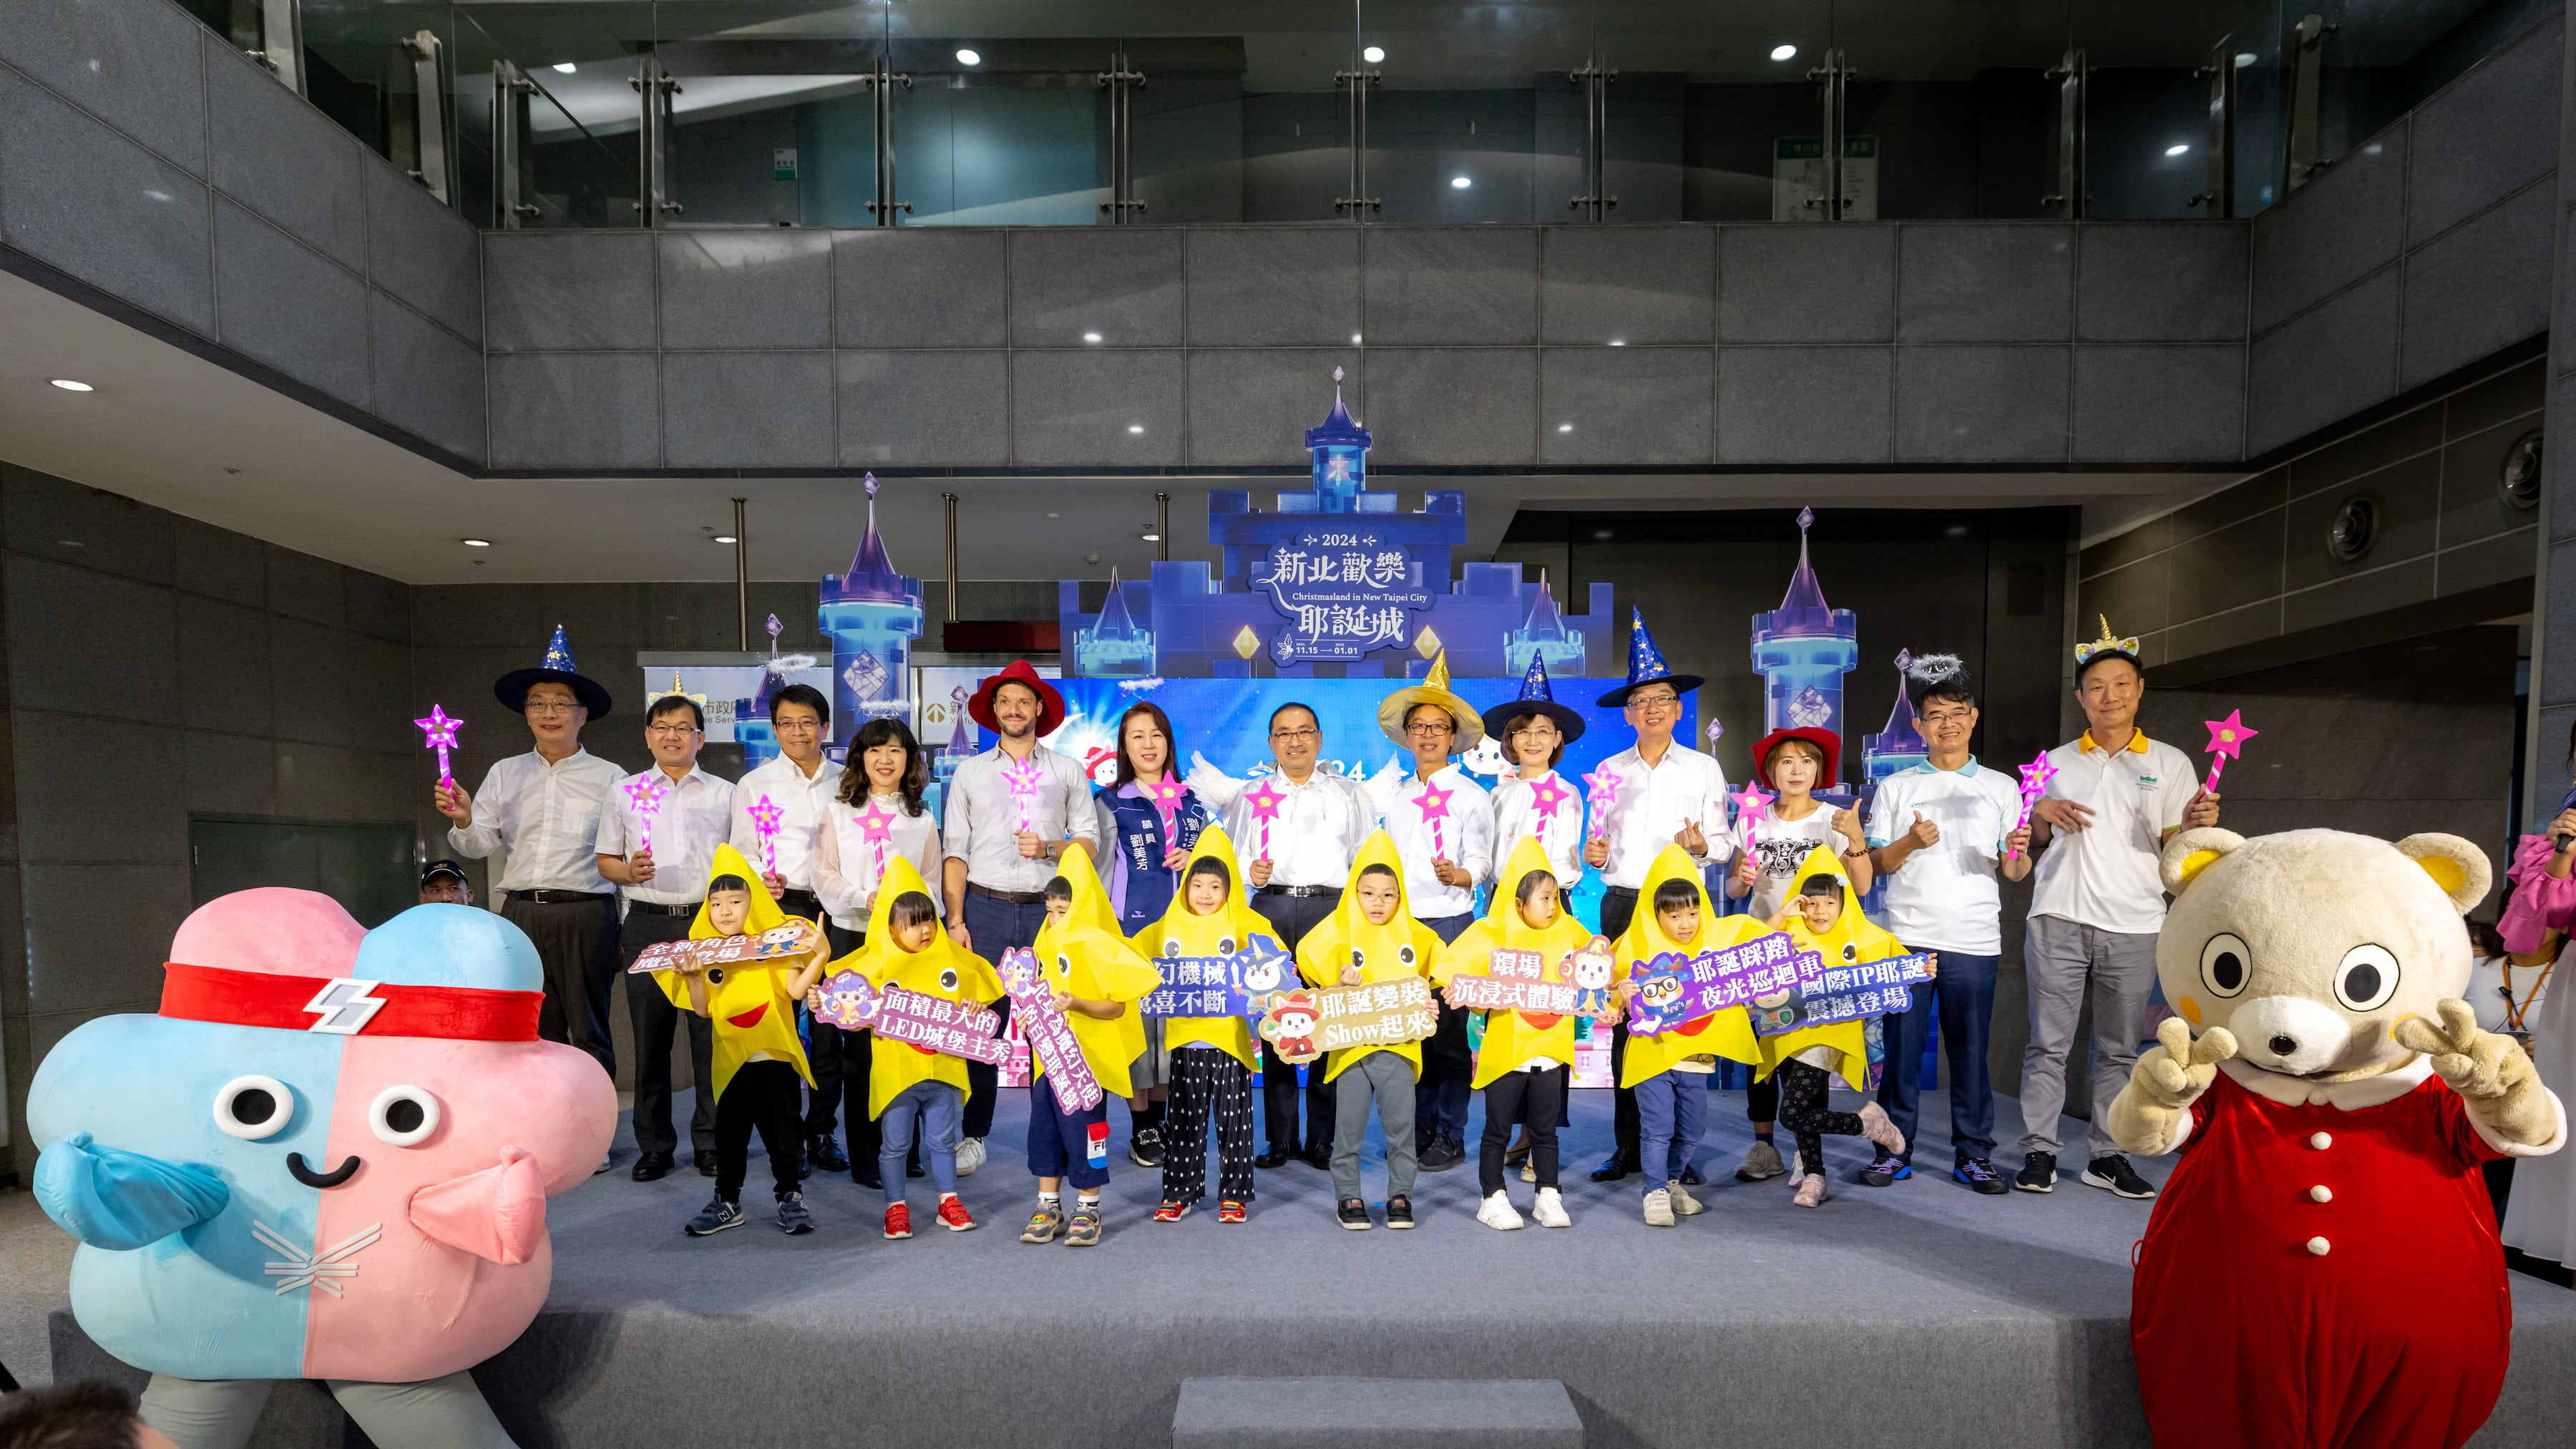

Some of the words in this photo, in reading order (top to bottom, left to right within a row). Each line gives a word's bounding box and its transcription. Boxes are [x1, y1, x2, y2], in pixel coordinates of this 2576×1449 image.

[1322, 535, 1357, 547] 2024
[1273, 547, 1406, 588] 新北歡樂
[1292, 592, 1350, 601] Christmasland
[1382, 593, 1408, 603] Taipei
[1410, 594, 1428, 603] City
[1292, 603, 1405, 644] 耶誕城
[1141, 819, 1156, 844] 議員
[1187, 817, 1200, 847] 劉美
[1130, 834, 1148, 870] 劉美芳
[643, 935, 747, 957] 全新角色
[1690, 936, 1789, 984] 耶誕踩踏
[1154, 961, 1226, 985] 幻機械
[1493, 952, 1541, 979] 環場
[1699, 955, 1823, 1010] 夜光巡迴車
[1801, 957, 1927, 998] 國際IP耶誕
[884, 988, 997, 1035] 面積最大的
[1319, 981, 1428, 1020] 耶誕變裝
[1454, 977, 1574, 1011] 沉浸式體驗
[1805, 986, 1908, 1023] 震撼登場
[879, 1014, 1013, 1064] LED城堡主秀
[1325, 1010, 1433, 1046] Show起來
